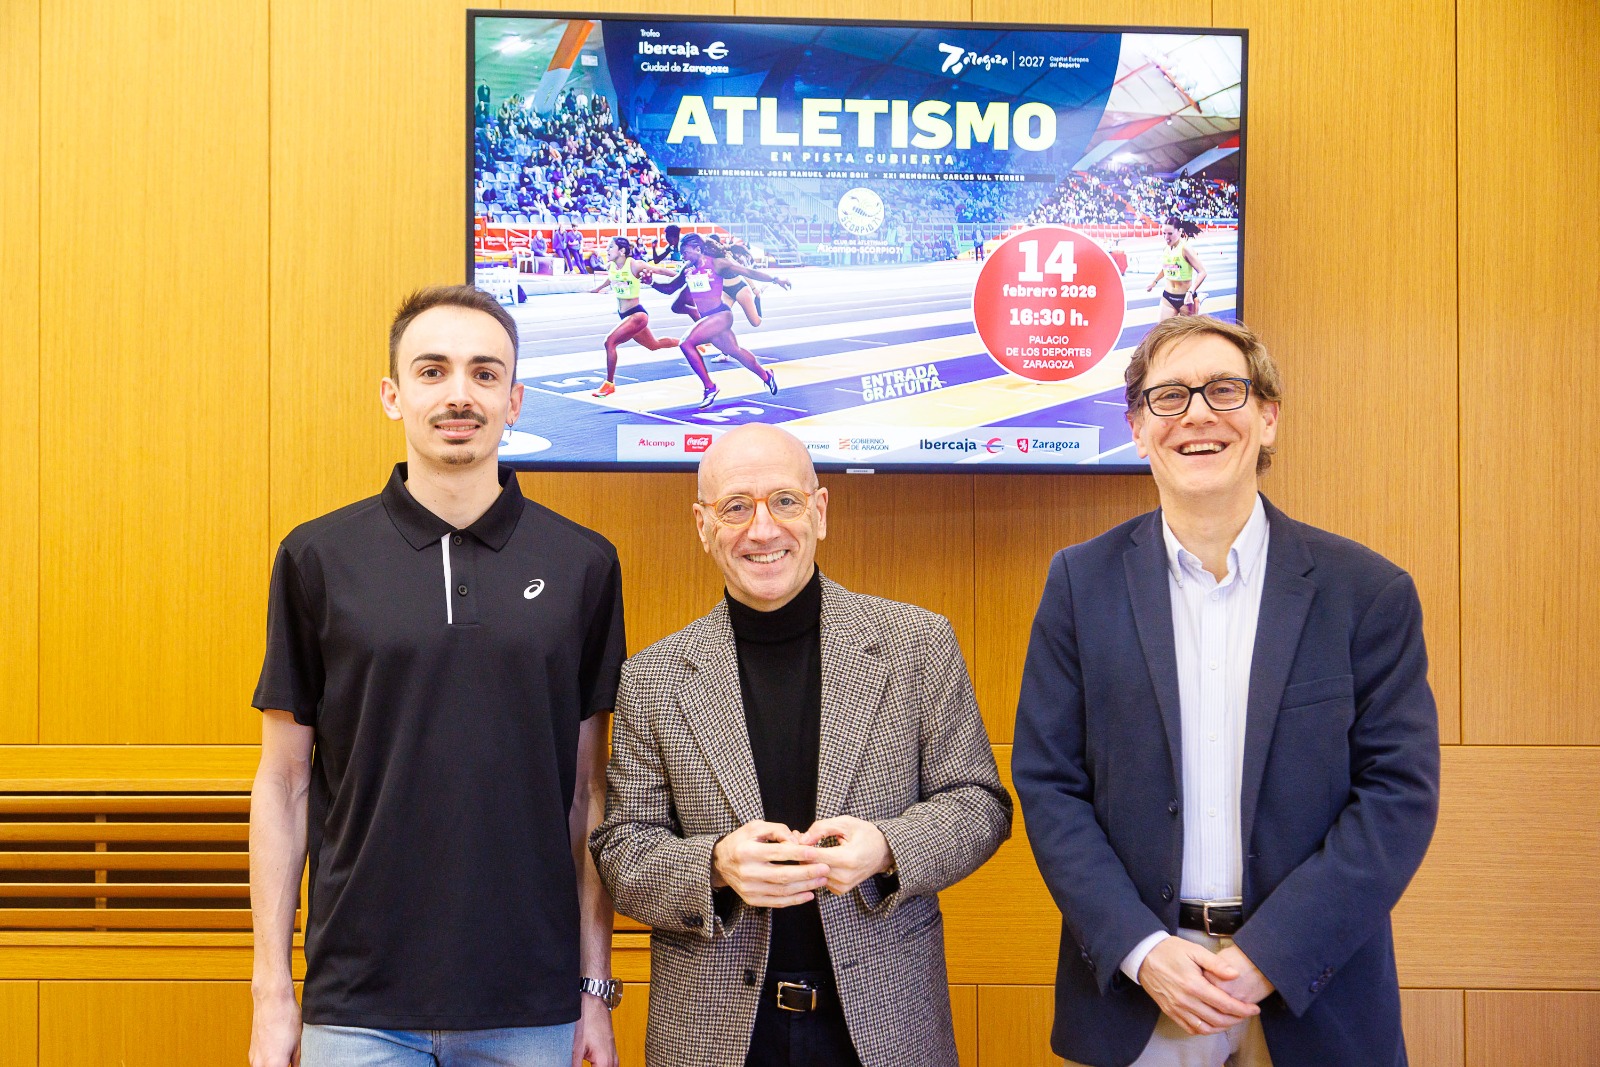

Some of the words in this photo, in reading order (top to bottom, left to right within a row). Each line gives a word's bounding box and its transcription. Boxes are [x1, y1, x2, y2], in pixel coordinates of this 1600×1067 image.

[640, 28, 660, 38] Trofeo
[638, 41, 700, 58] Ibercaja
[640, 61, 670, 72] Ciudad
[670, 62, 682, 72] de
[682, 62, 729, 75] Zaragoza
[1018, 56, 1044, 68] 2027
[666, 95, 1057, 152] ATLETISMO
[770, 152, 792, 162] EN
[802, 153, 855, 164] PISTA
[865, 154, 955, 166] CUBIERTA
[698, 168, 720, 176] XLVII
[790, 170, 823, 178] MANUEL
[943, 173, 974, 181] CARLOS
[1018, 240, 1077, 282] 14
[1002, 284, 1057, 298] febrero
[1060, 285, 1097, 298] 2026
[1009, 308, 1065, 326] 16:30
[1070, 309, 1089, 326] h.
[1029, 336, 1069, 344] PALACIO
[1006, 347, 1018, 356] DE
[1021, 347, 1040, 357] LOS
[1042, 348, 1092, 357] DEPORTES
[1023, 360, 1074, 369] ZARAGOZA
[861, 364, 939, 389] ENTRADA
[862, 376, 942, 402] GRATUITA
[638, 438, 675, 447] Alcampo
[920, 438, 977, 453] Ibercaja
[1032, 439, 1079, 451] Zaragoza
